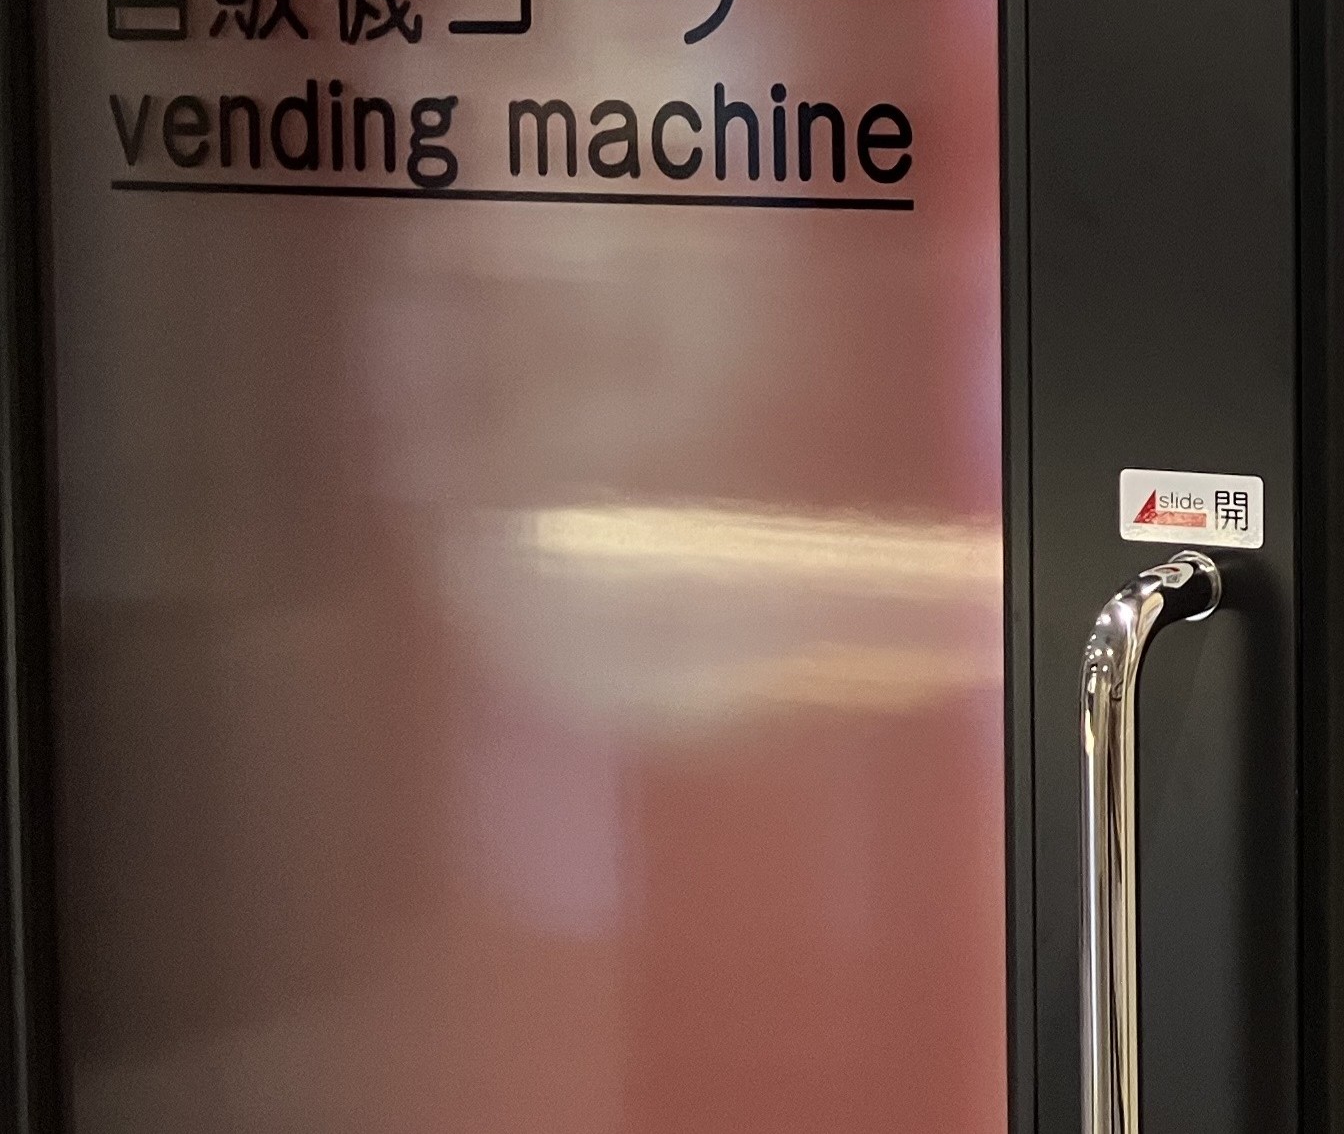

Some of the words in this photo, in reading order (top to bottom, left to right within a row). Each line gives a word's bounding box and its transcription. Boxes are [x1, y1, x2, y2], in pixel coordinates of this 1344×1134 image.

[109, 80, 459, 188] vending
[508, 82, 914, 185] machine
[1158, 491, 1204, 510] slide
[1214, 490, 1249, 532] 開
